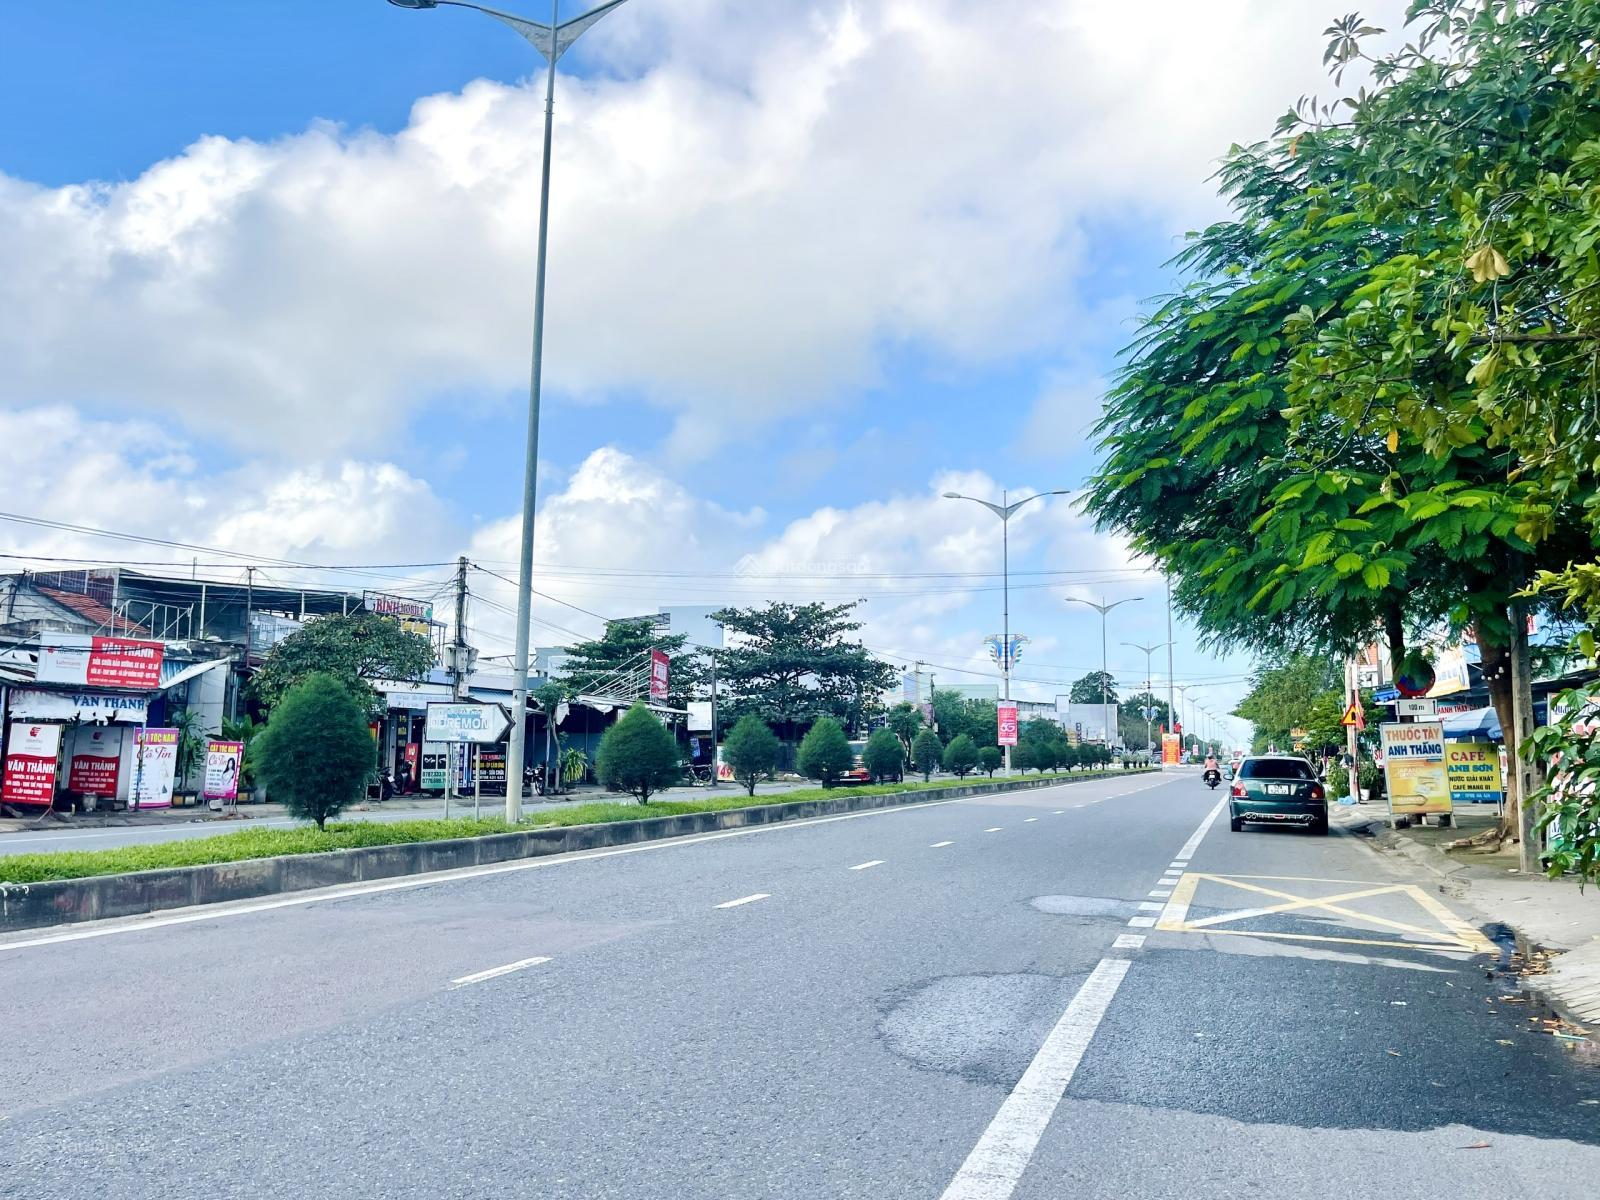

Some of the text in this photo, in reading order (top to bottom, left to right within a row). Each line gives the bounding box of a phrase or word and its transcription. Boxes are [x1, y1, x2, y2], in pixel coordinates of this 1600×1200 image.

[1385, 725, 1440, 742] THUỐC TÂY
[1388, 741, 1442, 757] ANH THẮNG
[1448, 764, 1470, 773] ANH
